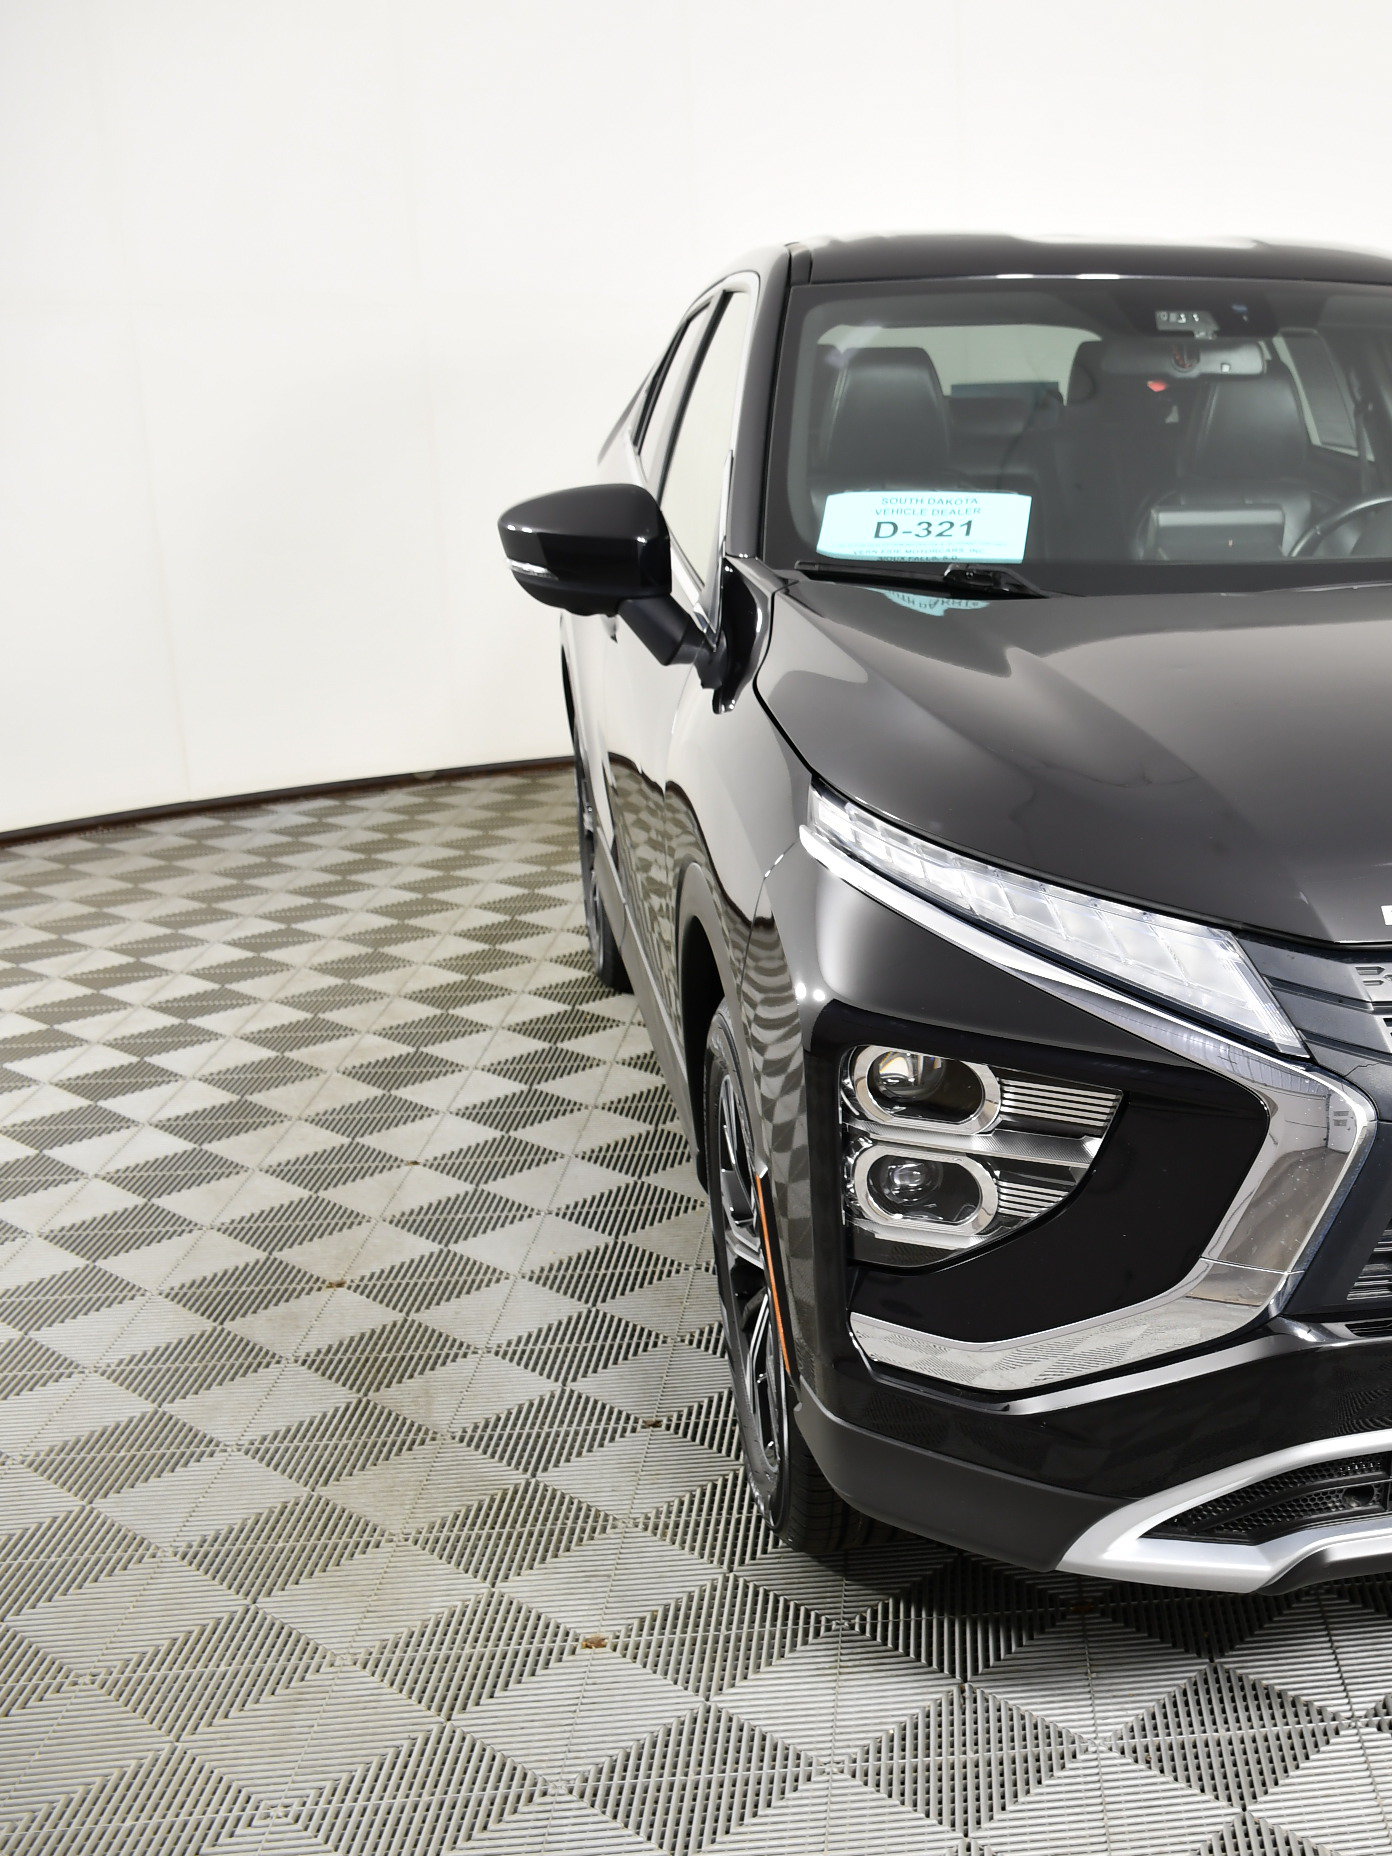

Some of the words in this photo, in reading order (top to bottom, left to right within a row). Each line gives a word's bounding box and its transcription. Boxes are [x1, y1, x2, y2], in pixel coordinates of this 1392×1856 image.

[875, 508, 926, 517] VEHICLE
[931, 507, 982, 516] DEALER
[874, 520, 974, 538] D-321
